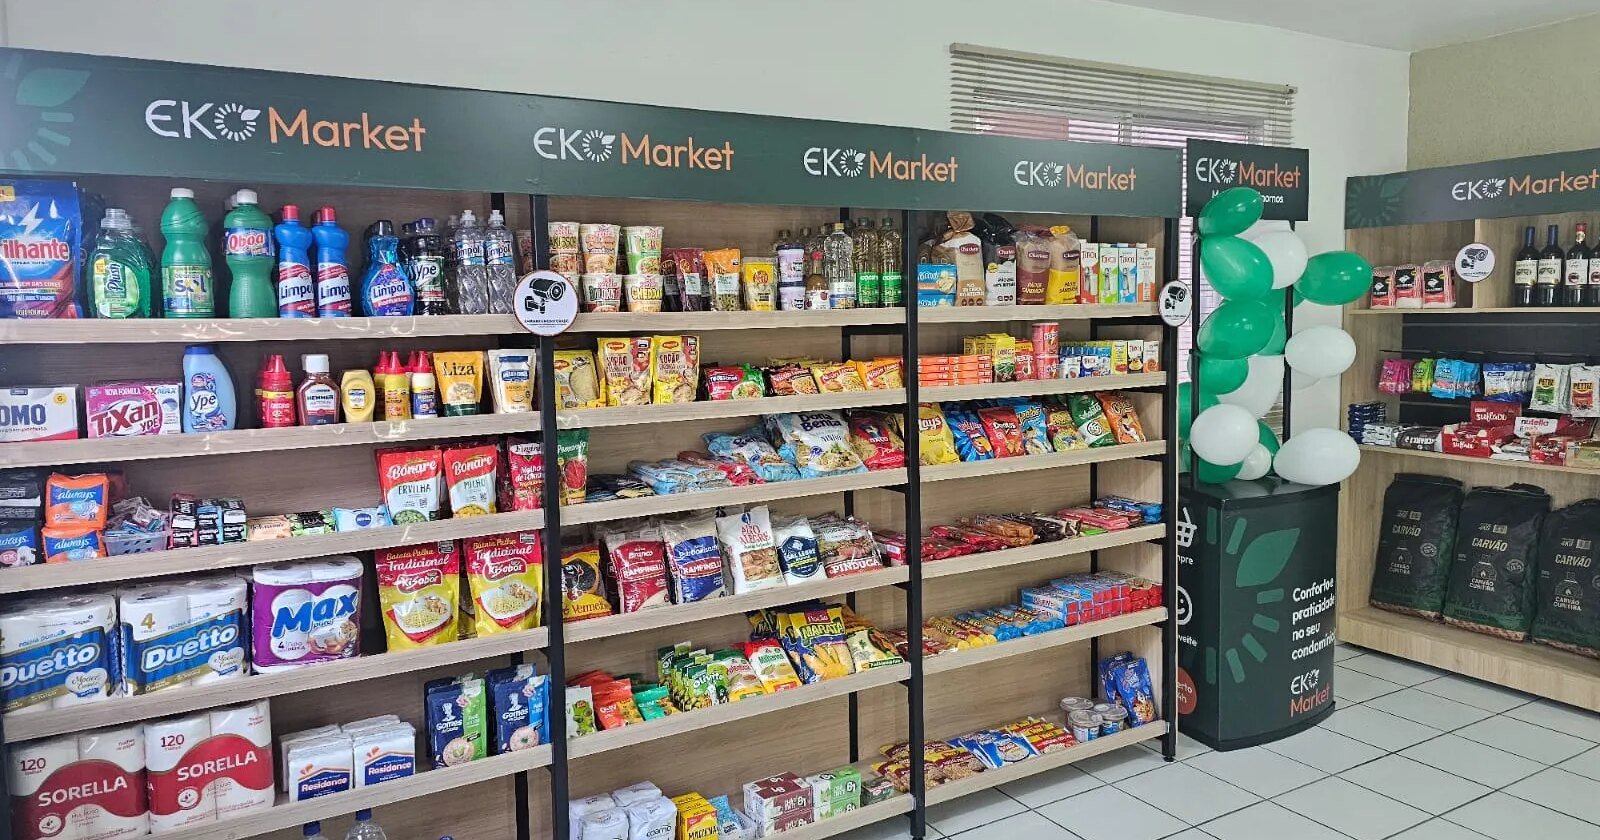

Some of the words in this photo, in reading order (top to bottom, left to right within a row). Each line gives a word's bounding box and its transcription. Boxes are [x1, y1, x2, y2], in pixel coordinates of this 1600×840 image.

[268, 106, 426, 152] Market
[620, 132, 735, 171] Market
[869, 150, 958, 183] Market
[1238, 160, 1301, 188] Market
[1066, 163, 1137, 191] Market
[1508, 168, 1600, 197] Market
[228, 232, 265, 250] Qboa
[106, 262, 121, 292] Plush
[371, 283, 407, 299] Limpol
[442, 361, 477, 376] Liza
[0, 403, 47, 426] OMO
[1521, 418, 1550, 428] nutella
[801, 419, 842, 432] Benta
[387, 460, 438, 480] Bonare
[452, 455, 494, 476] Bonare
[398, 484, 431, 495] ERVILHA
[463, 479, 486, 489] MILHO
[57, 491, 97, 500] always
[1392, 524, 1422, 537] CARVÃO
[54, 537, 91, 550] always
[1471, 536, 1508, 552] CARVÃO
[474, 544, 533, 561] Tradicional
[1555, 553, 1592, 569] CARVÃO
[388, 553, 450, 572] Tradicional
[832, 558, 881, 574] PINDUCA
[1292, 580, 1329, 603] Conforto
[140, 612, 156, 630] 4
[272, 591, 358, 638] Max
[1292, 628, 1305, 642] no
[1305, 622, 1321, 636] seu
[145, 625, 238, 669] Duetto
[278, 641, 285, 649] 4
[0, 645, 96, 688] Duetto
[1290, 686, 1330, 718] Market
[502, 707, 529, 720] Gomes
[436, 719, 463, 731] Gomes
[160, 734, 185, 748] 120
[20, 757, 47, 772] 120
[177, 750, 258, 782] SORELLA
[368, 761, 412, 776] Residence
[38, 776, 128, 807] SORELLA
[301, 776, 348, 793] Residence
[646, 825, 672, 838] coamo
